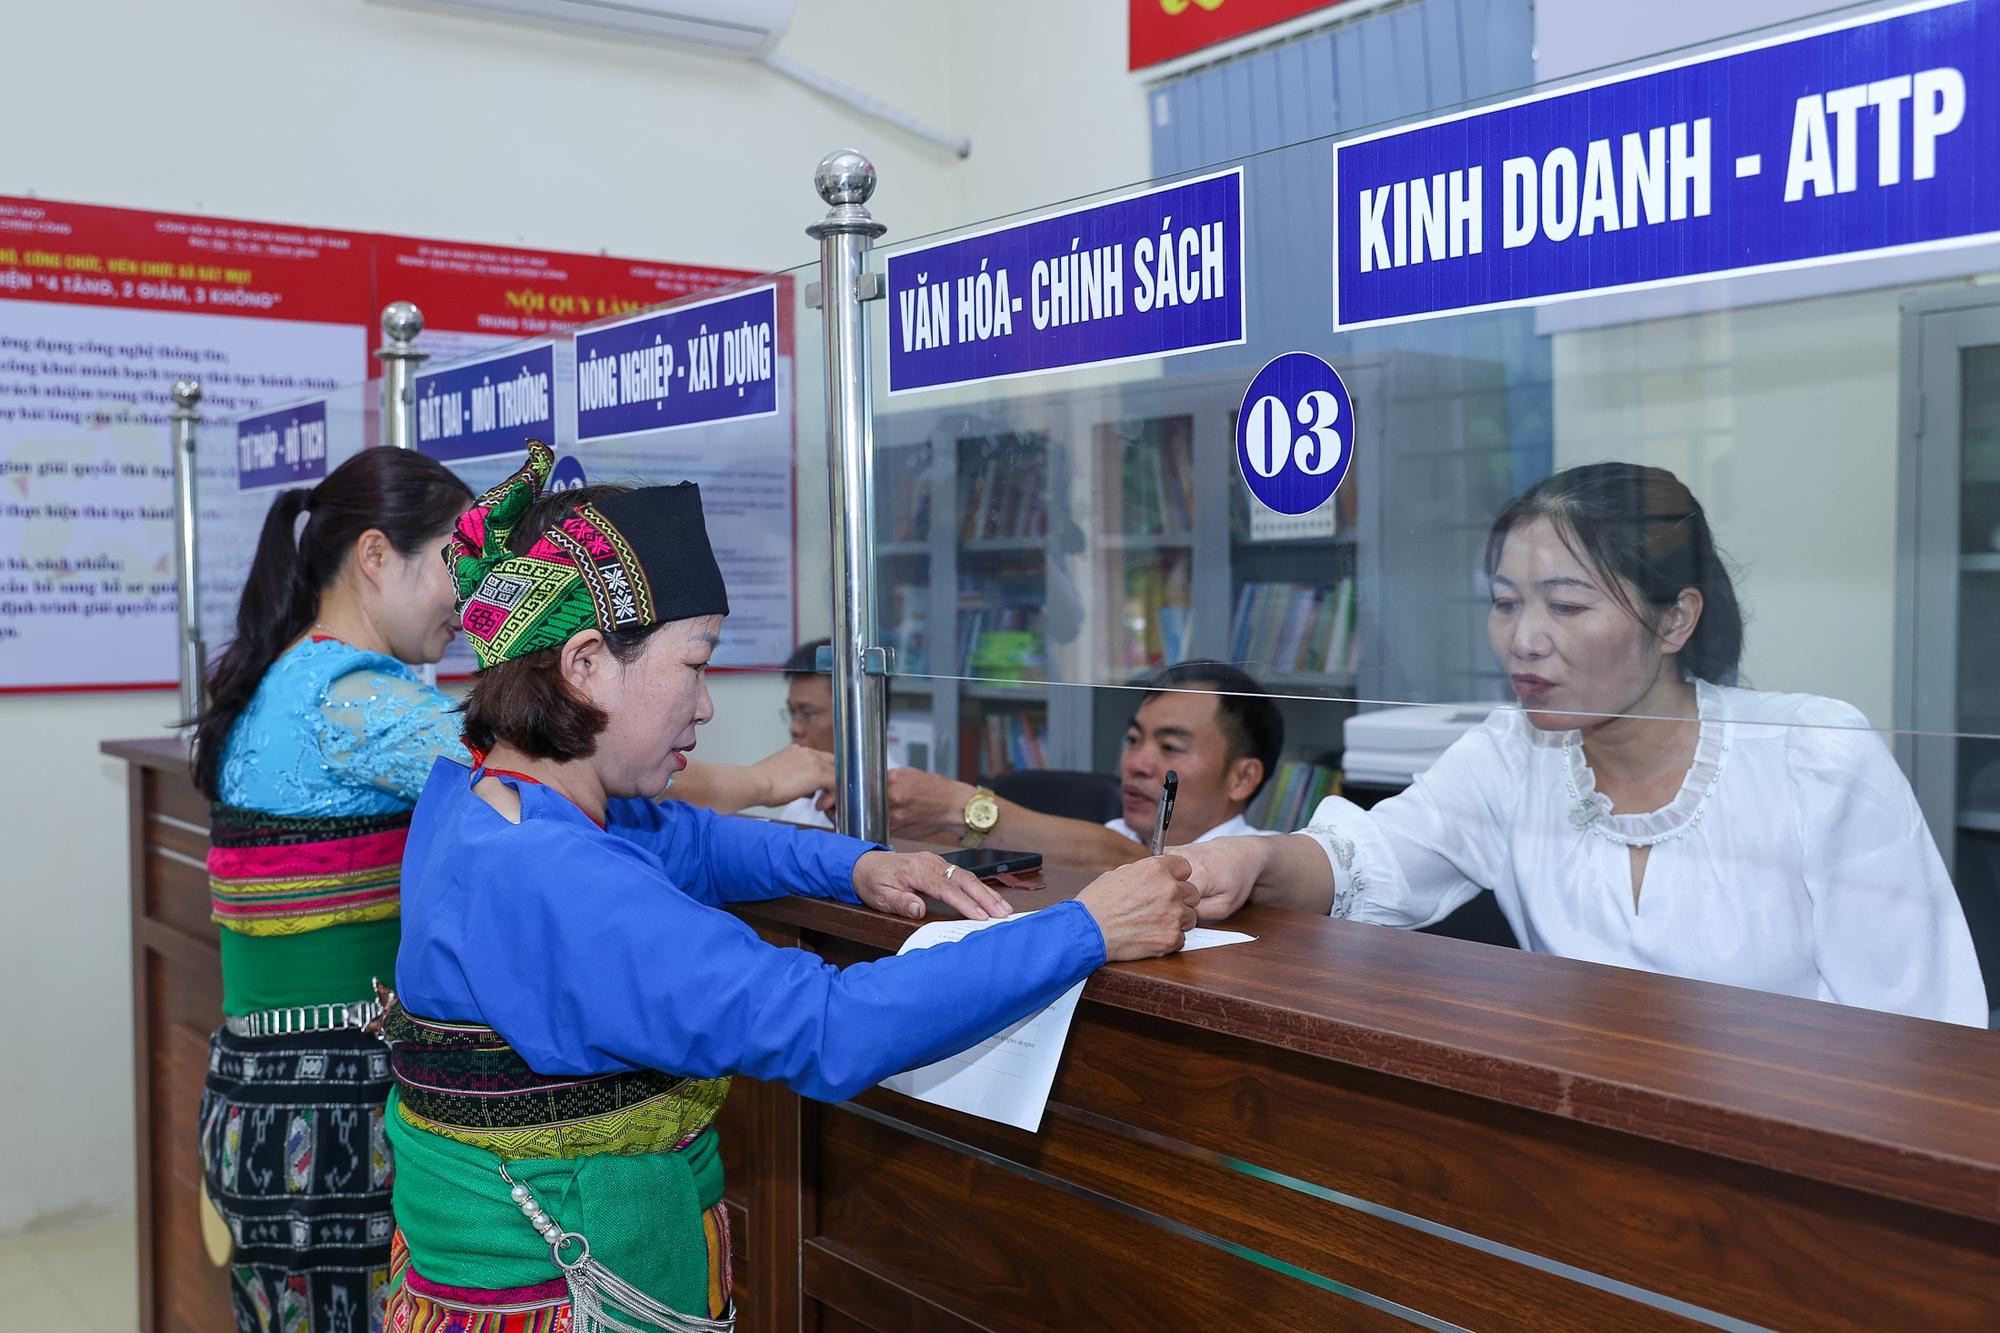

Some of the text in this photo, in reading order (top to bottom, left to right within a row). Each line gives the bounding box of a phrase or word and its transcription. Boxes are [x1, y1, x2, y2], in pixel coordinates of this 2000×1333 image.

[1359, 66, 1966, 274] KINH DOANH - ATTP
[900, 216, 1225, 352] VĂN HÓA- CHÍNH SÁCH
[472, 375, 496, 433] MÔI
[497, 365, 548, 428] TRƯỜNG
[579, 349, 618, 412] NÔNG
[620, 334, 674, 411] NGHIỆP
[687, 324, 720, 393] XÂY
[723, 320, 771, 397] DỰNG
[1245, 390, 1342, 478] 03
